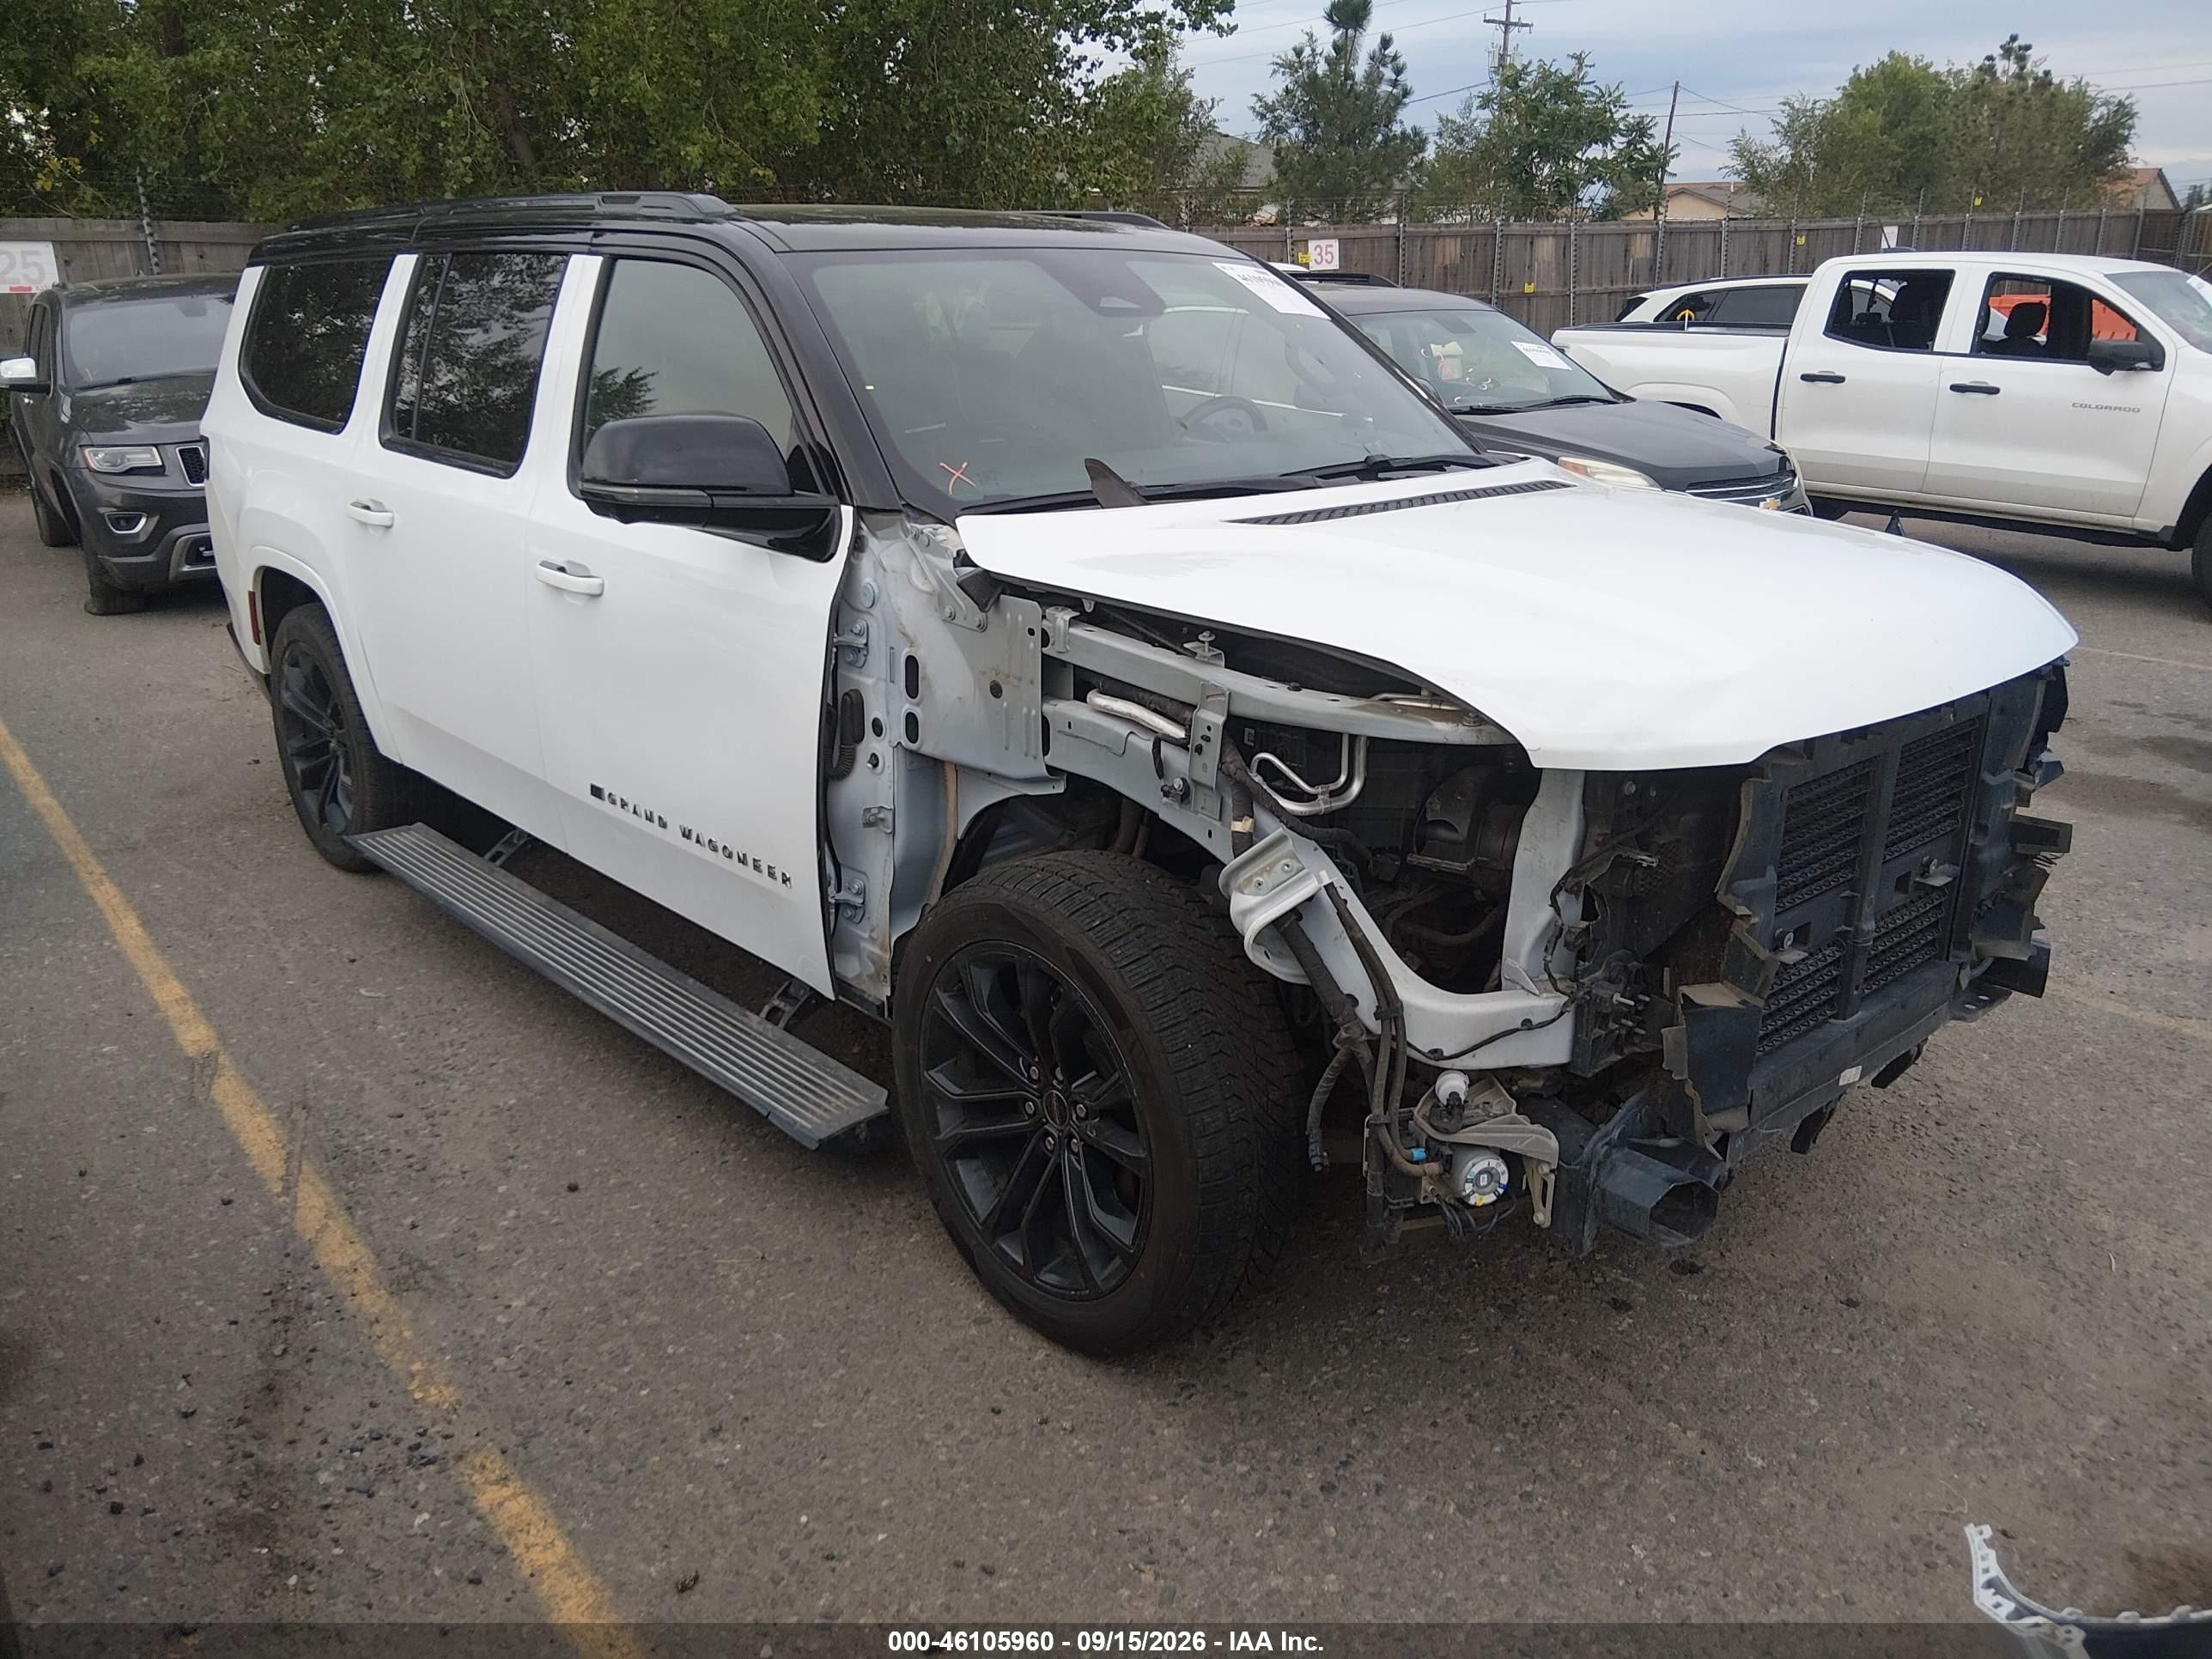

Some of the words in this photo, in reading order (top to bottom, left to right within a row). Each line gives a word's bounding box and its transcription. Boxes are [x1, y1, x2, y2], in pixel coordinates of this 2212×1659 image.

[0, 249, 46, 284] 25
[1314, 244, 1334, 264] 35
[2072, 403, 2141, 413] COLORADO
[607, 791, 668, 830] GRAND
[679, 823, 793, 889] WAGONEER
